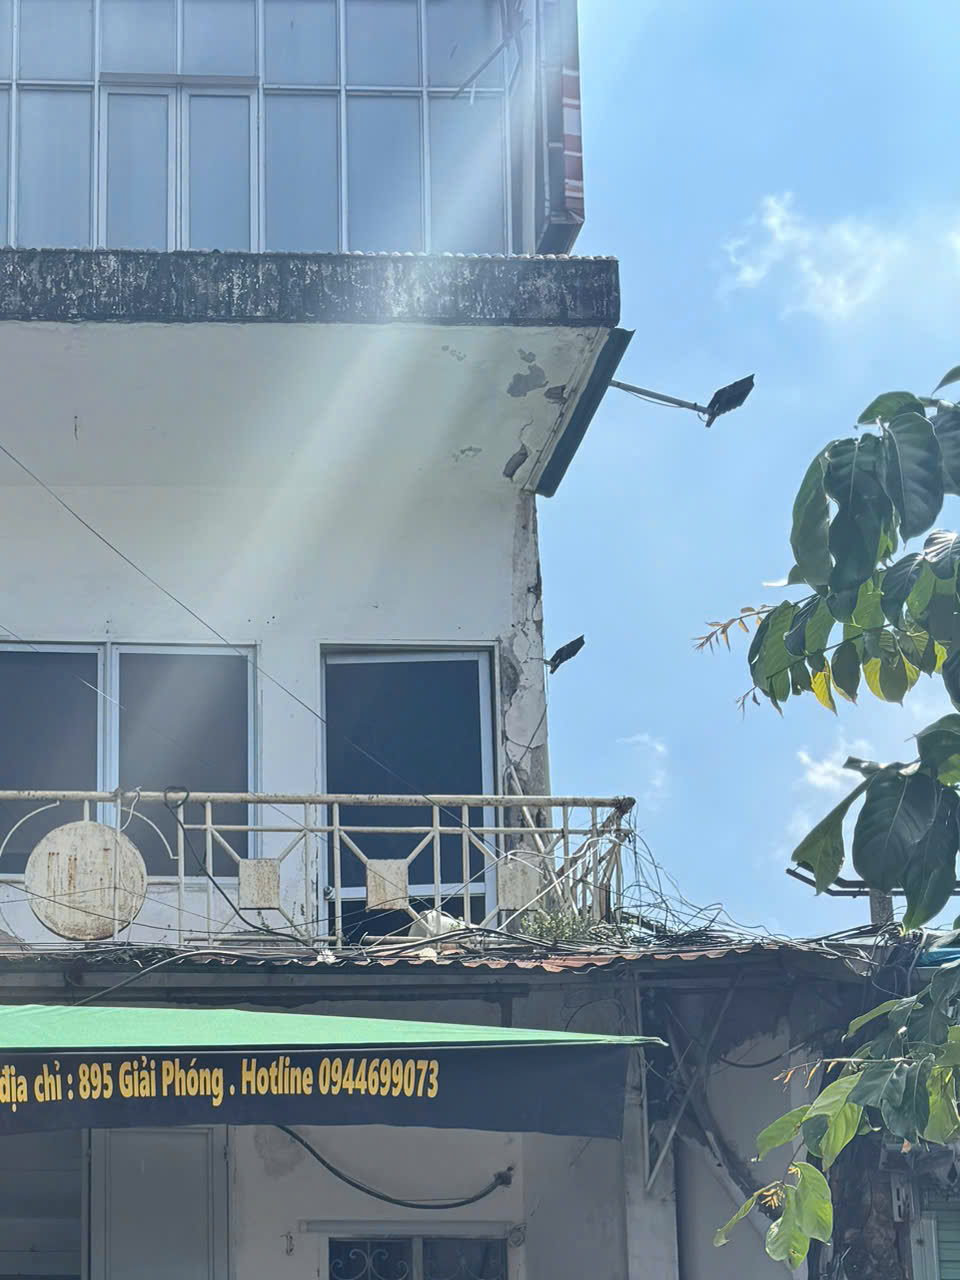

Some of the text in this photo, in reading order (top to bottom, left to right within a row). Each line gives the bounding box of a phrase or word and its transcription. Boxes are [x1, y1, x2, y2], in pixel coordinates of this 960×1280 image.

[34, 1060, 62, 1102] chỉ
[78, 1063, 113, 1100] 895
[119, 1055, 156, 1097] Giải
[162, 1058, 224, 1107] Phóng
[241, 1056, 313, 1095] Hotline
[318, 1057, 439, 1098] 0944699073
